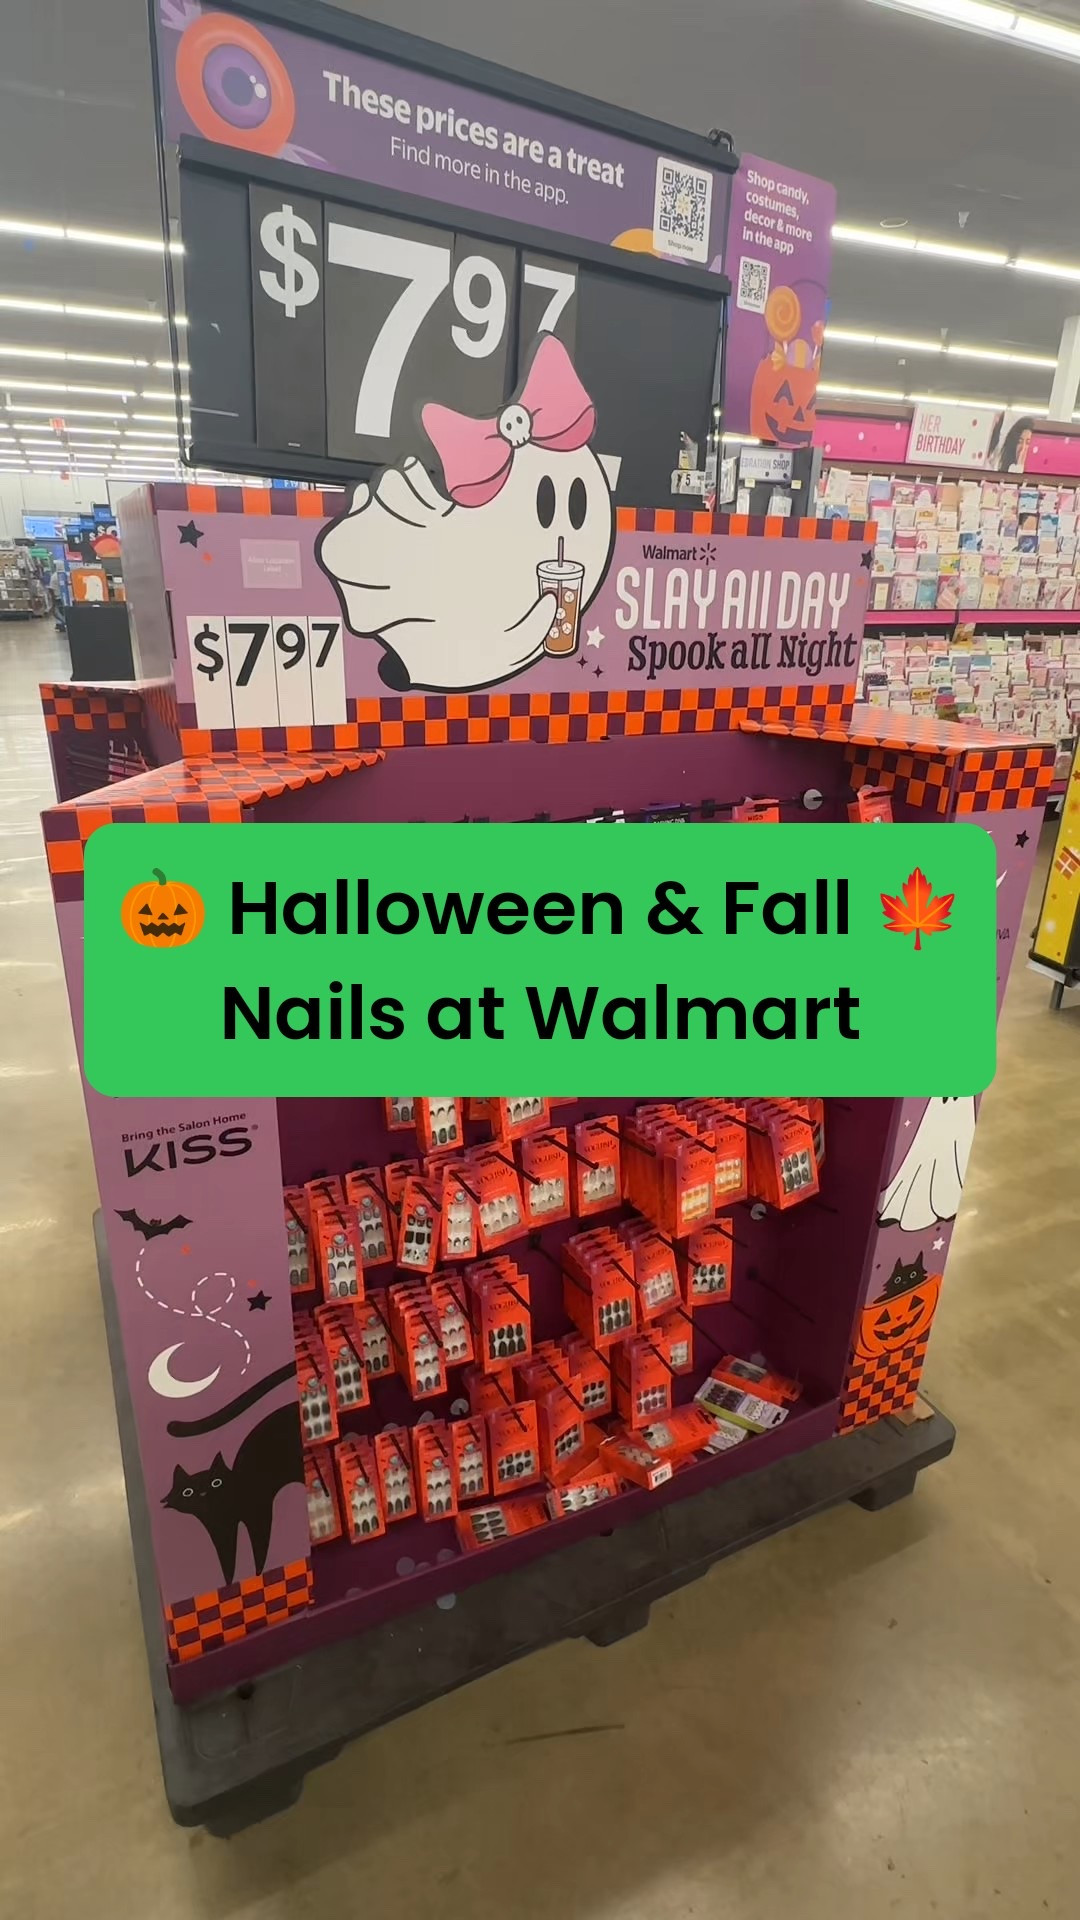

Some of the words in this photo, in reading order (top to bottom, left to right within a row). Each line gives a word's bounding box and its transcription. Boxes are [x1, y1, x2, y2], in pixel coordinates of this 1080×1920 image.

[323, 70, 411, 125] These
[417, 104, 498, 150] prices
[502, 131, 544, 164] are
[548, 146, 562, 169] a
[567, 148, 625, 188] treat
[391, 136, 430, 166] Find
[435, 152, 481, 180] more
[485, 163, 500, 186] in
[504, 169, 531, 194] the
[534, 182, 569, 206] app.
[747, 169, 775, 193] Shop
[776, 182, 809, 205] candy,
[746, 190, 800, 221] costumes,
[742, 226, 754, 242] in
[755, 231, 773, 248] the
[774, 239, 794, 256] app
[744, 208, 776, 230] decor
[776, 219, 785, 233] &
[785, 223, 813, 242] more
[921, 414, 942, 433] HER
[916, 434, 966, 456] BIRTHDAY
[773, 459, 790, 470] SHOP
[642, 544, 697, 561] Walmart
[615, 566, 717, 630] SLAY
[776, 571, 850, 630] DAY
[628, 632, 727, 680] Spook
[730, 632, 772, 670] all
[777, 630, 858, 676] Night
[121, 1131, 153, 1143] Bring
[156, 1126, 176, 1137] the
[178, 1119, 210, 1133] Salon
[213, 1112, 247, 1125] Home
[124, 1127, 253, 1178] KISS
